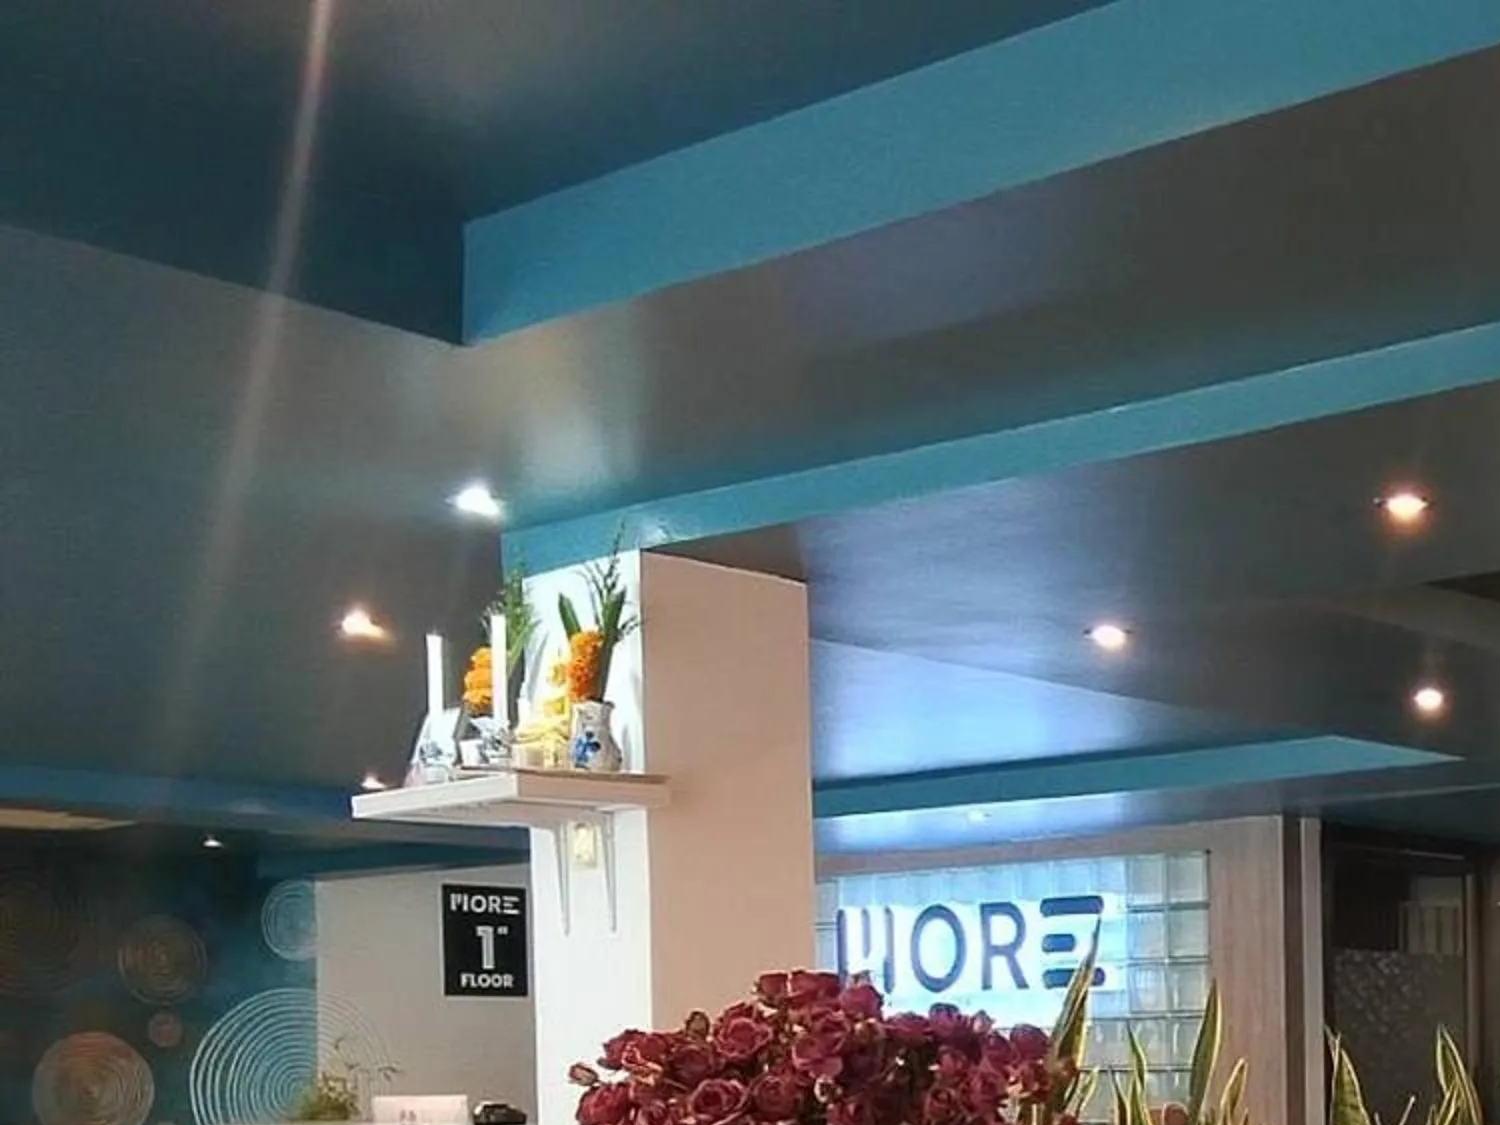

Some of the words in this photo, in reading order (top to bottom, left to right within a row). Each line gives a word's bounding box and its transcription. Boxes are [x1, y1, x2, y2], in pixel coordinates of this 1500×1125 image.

[449, 893, 520, 915] MORE
[836, 894, 1106, 994] MORE
[461, 972, 515, 988] FLOOR
